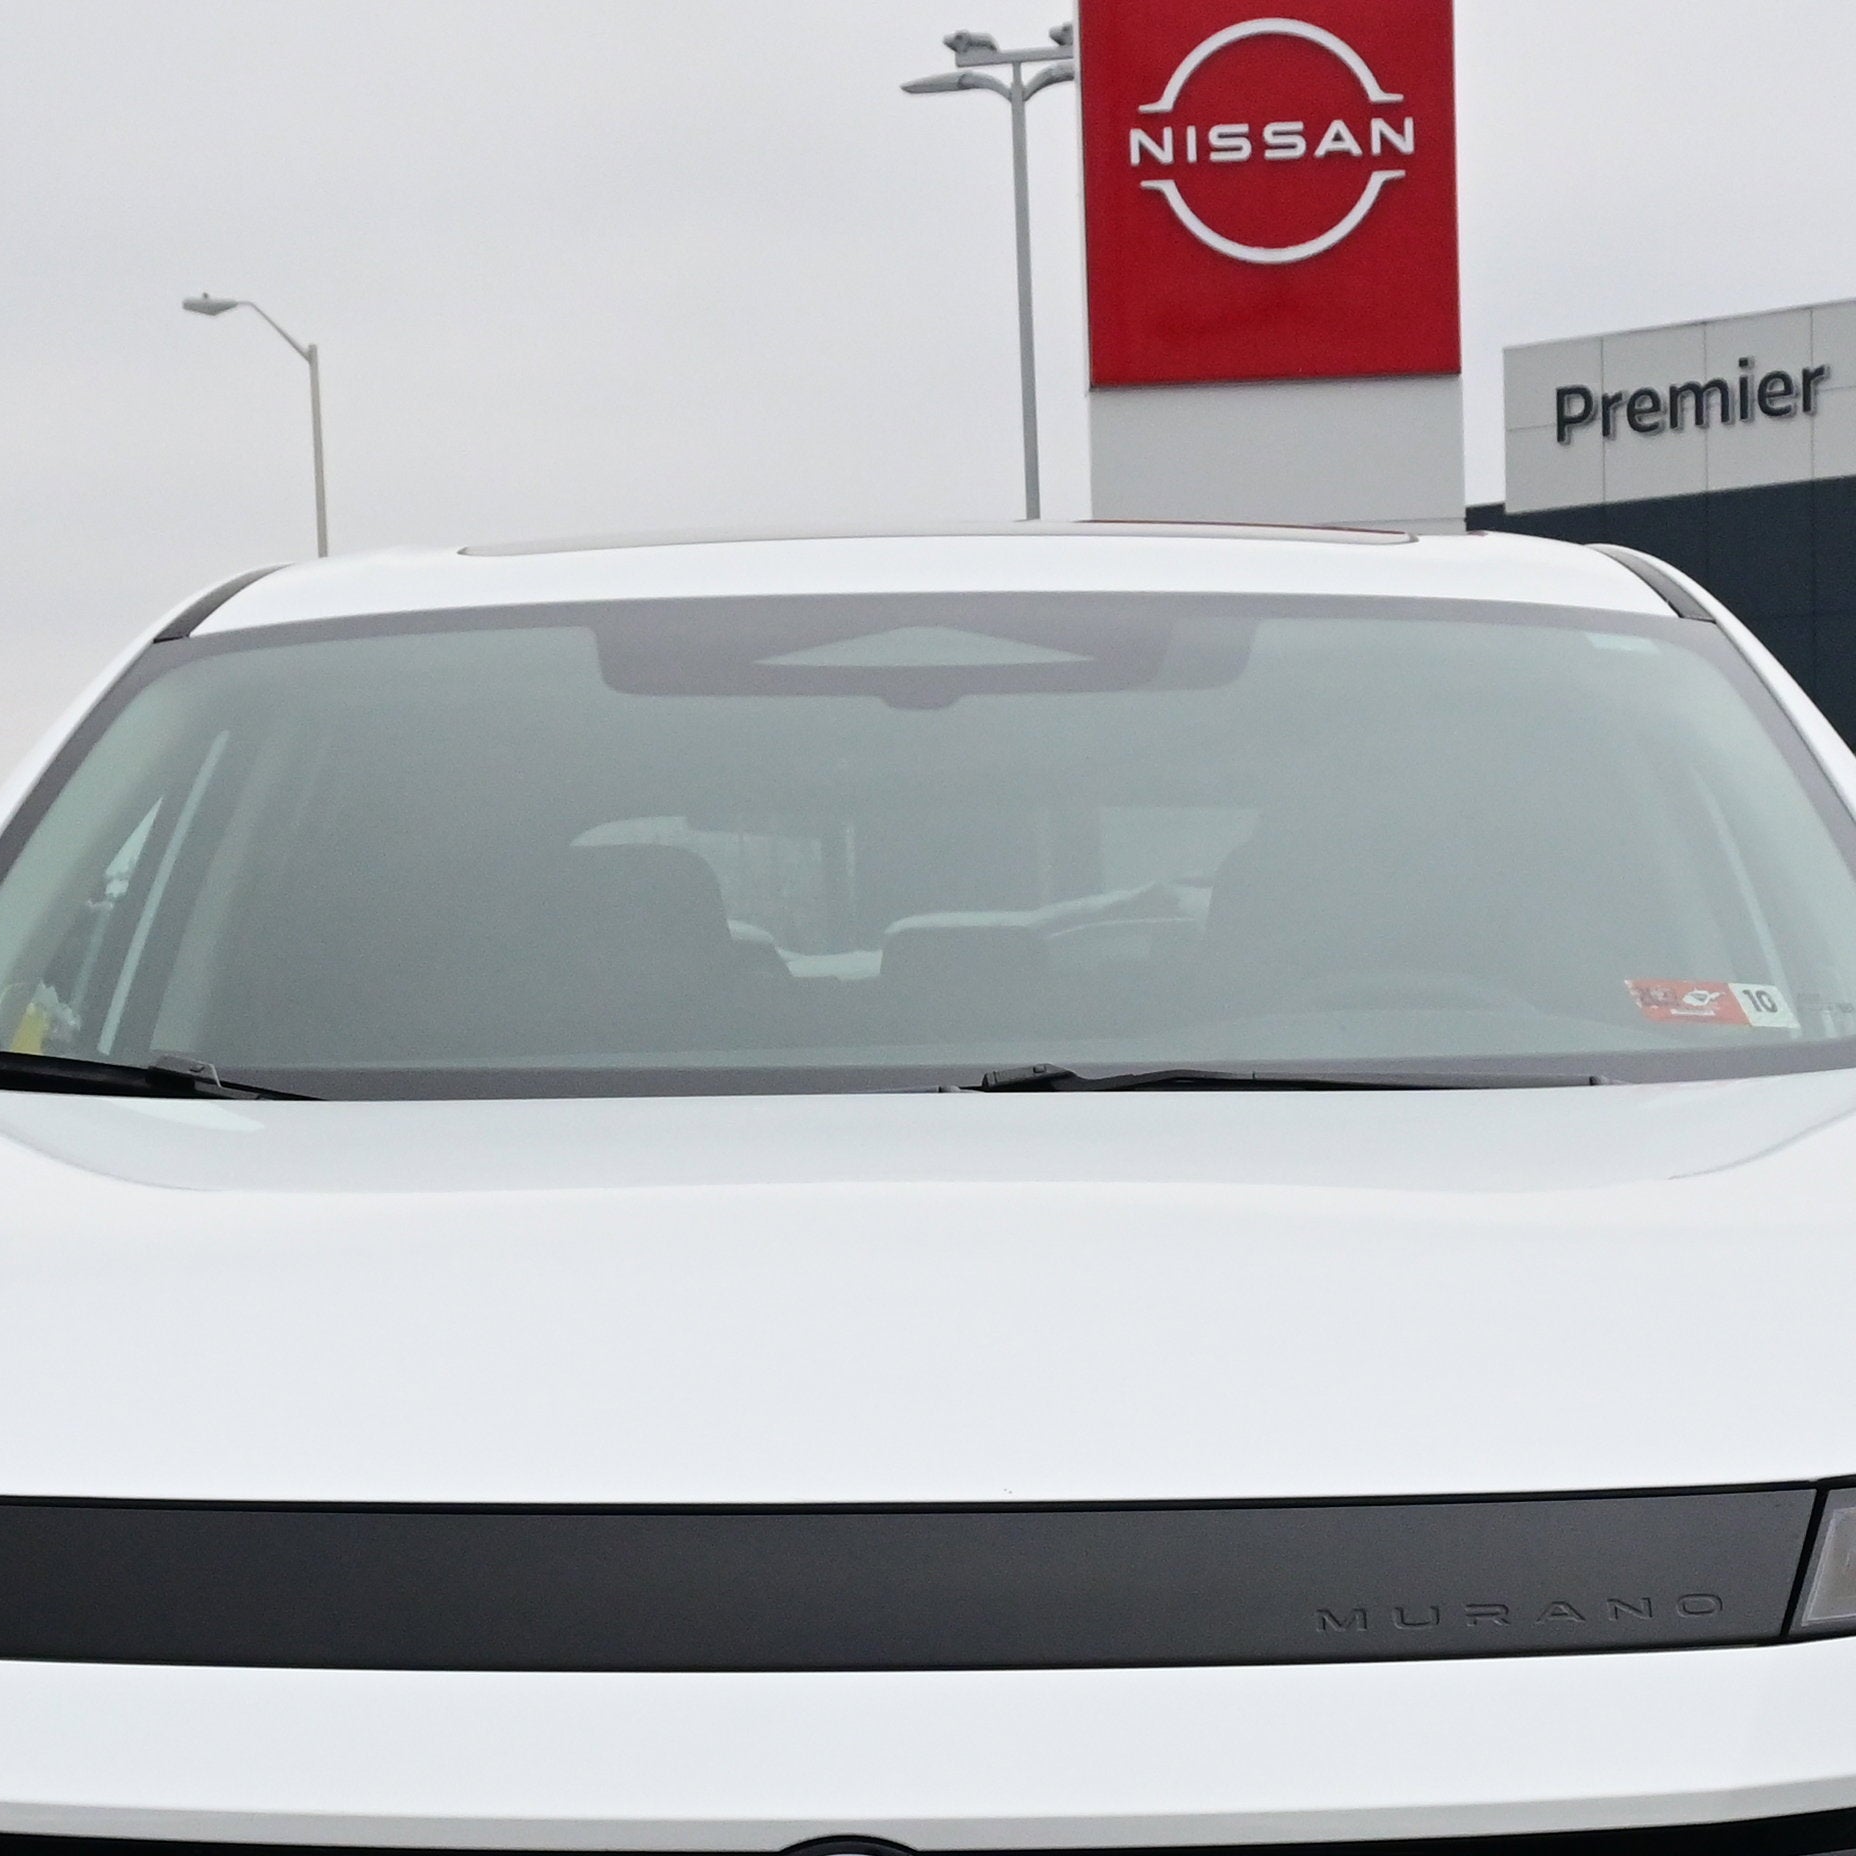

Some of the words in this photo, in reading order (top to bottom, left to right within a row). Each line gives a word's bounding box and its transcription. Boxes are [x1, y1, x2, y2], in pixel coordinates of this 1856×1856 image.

[1130, 116, 1415, 166] NISSAN
[1555, 357, 1828, 445] Premier
[1742, 989, 1778, 1014] 10
[1315, 1593, 1724, 1634] MURANO
